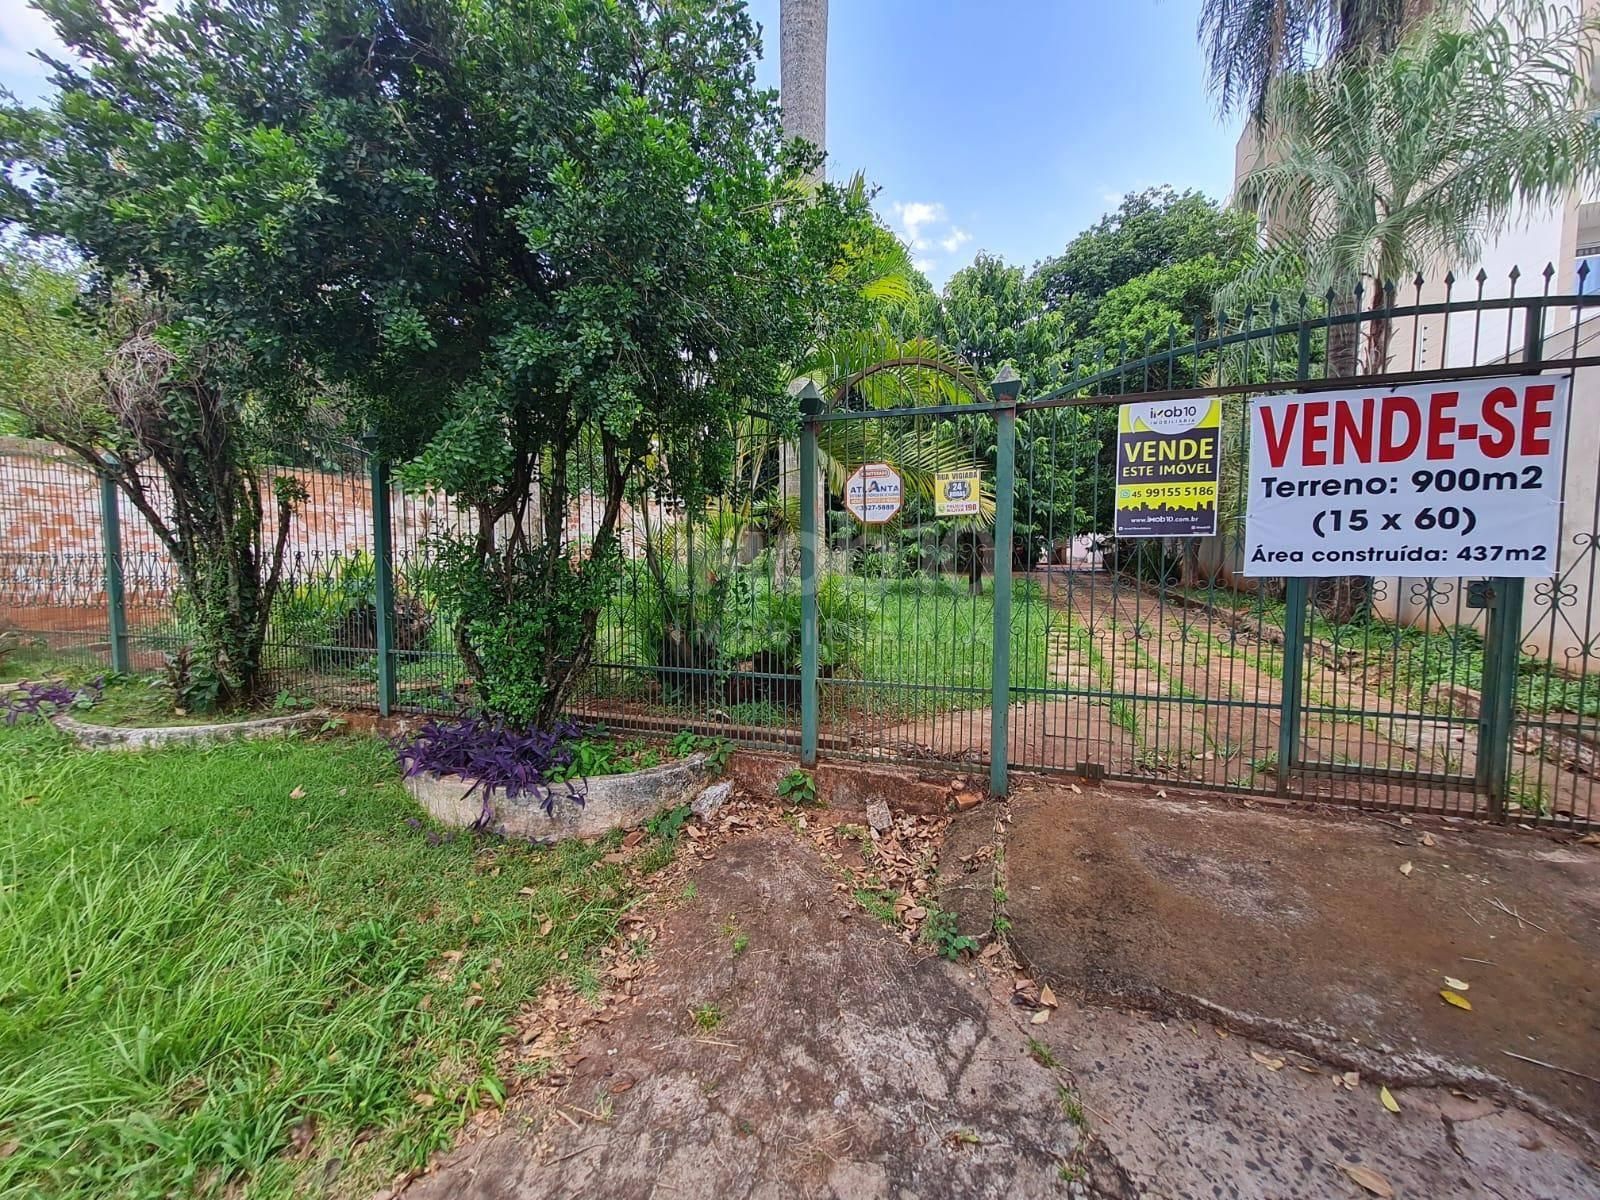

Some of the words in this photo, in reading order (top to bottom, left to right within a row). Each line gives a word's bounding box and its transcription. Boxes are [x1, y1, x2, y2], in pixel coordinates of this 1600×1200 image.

[1259, 385, 1555, 468] VENDE-SE
[1124, 439, 1213, 462] VENDE
[1123, 466, 1153, 477] ESTE
[1159, 463, 1212, 475] IMÓVEL
[1261, 476, 1398, 498] Terreno:
[1412, 465, 1543, 493] 900m2
[1146, 488, 1181, 498] 99155
[1185, 487, 1213, 497] 5186
[1312, 509, 1369, 538] (15
[1381, 514, 1402, 530] x
[1414, 506, 1477, 536] 60)
[1251, 545, 1304, 563] Área
[1312, 544, 1448, 562] construída:
[1457, 544, 1547, 561] 437m2
